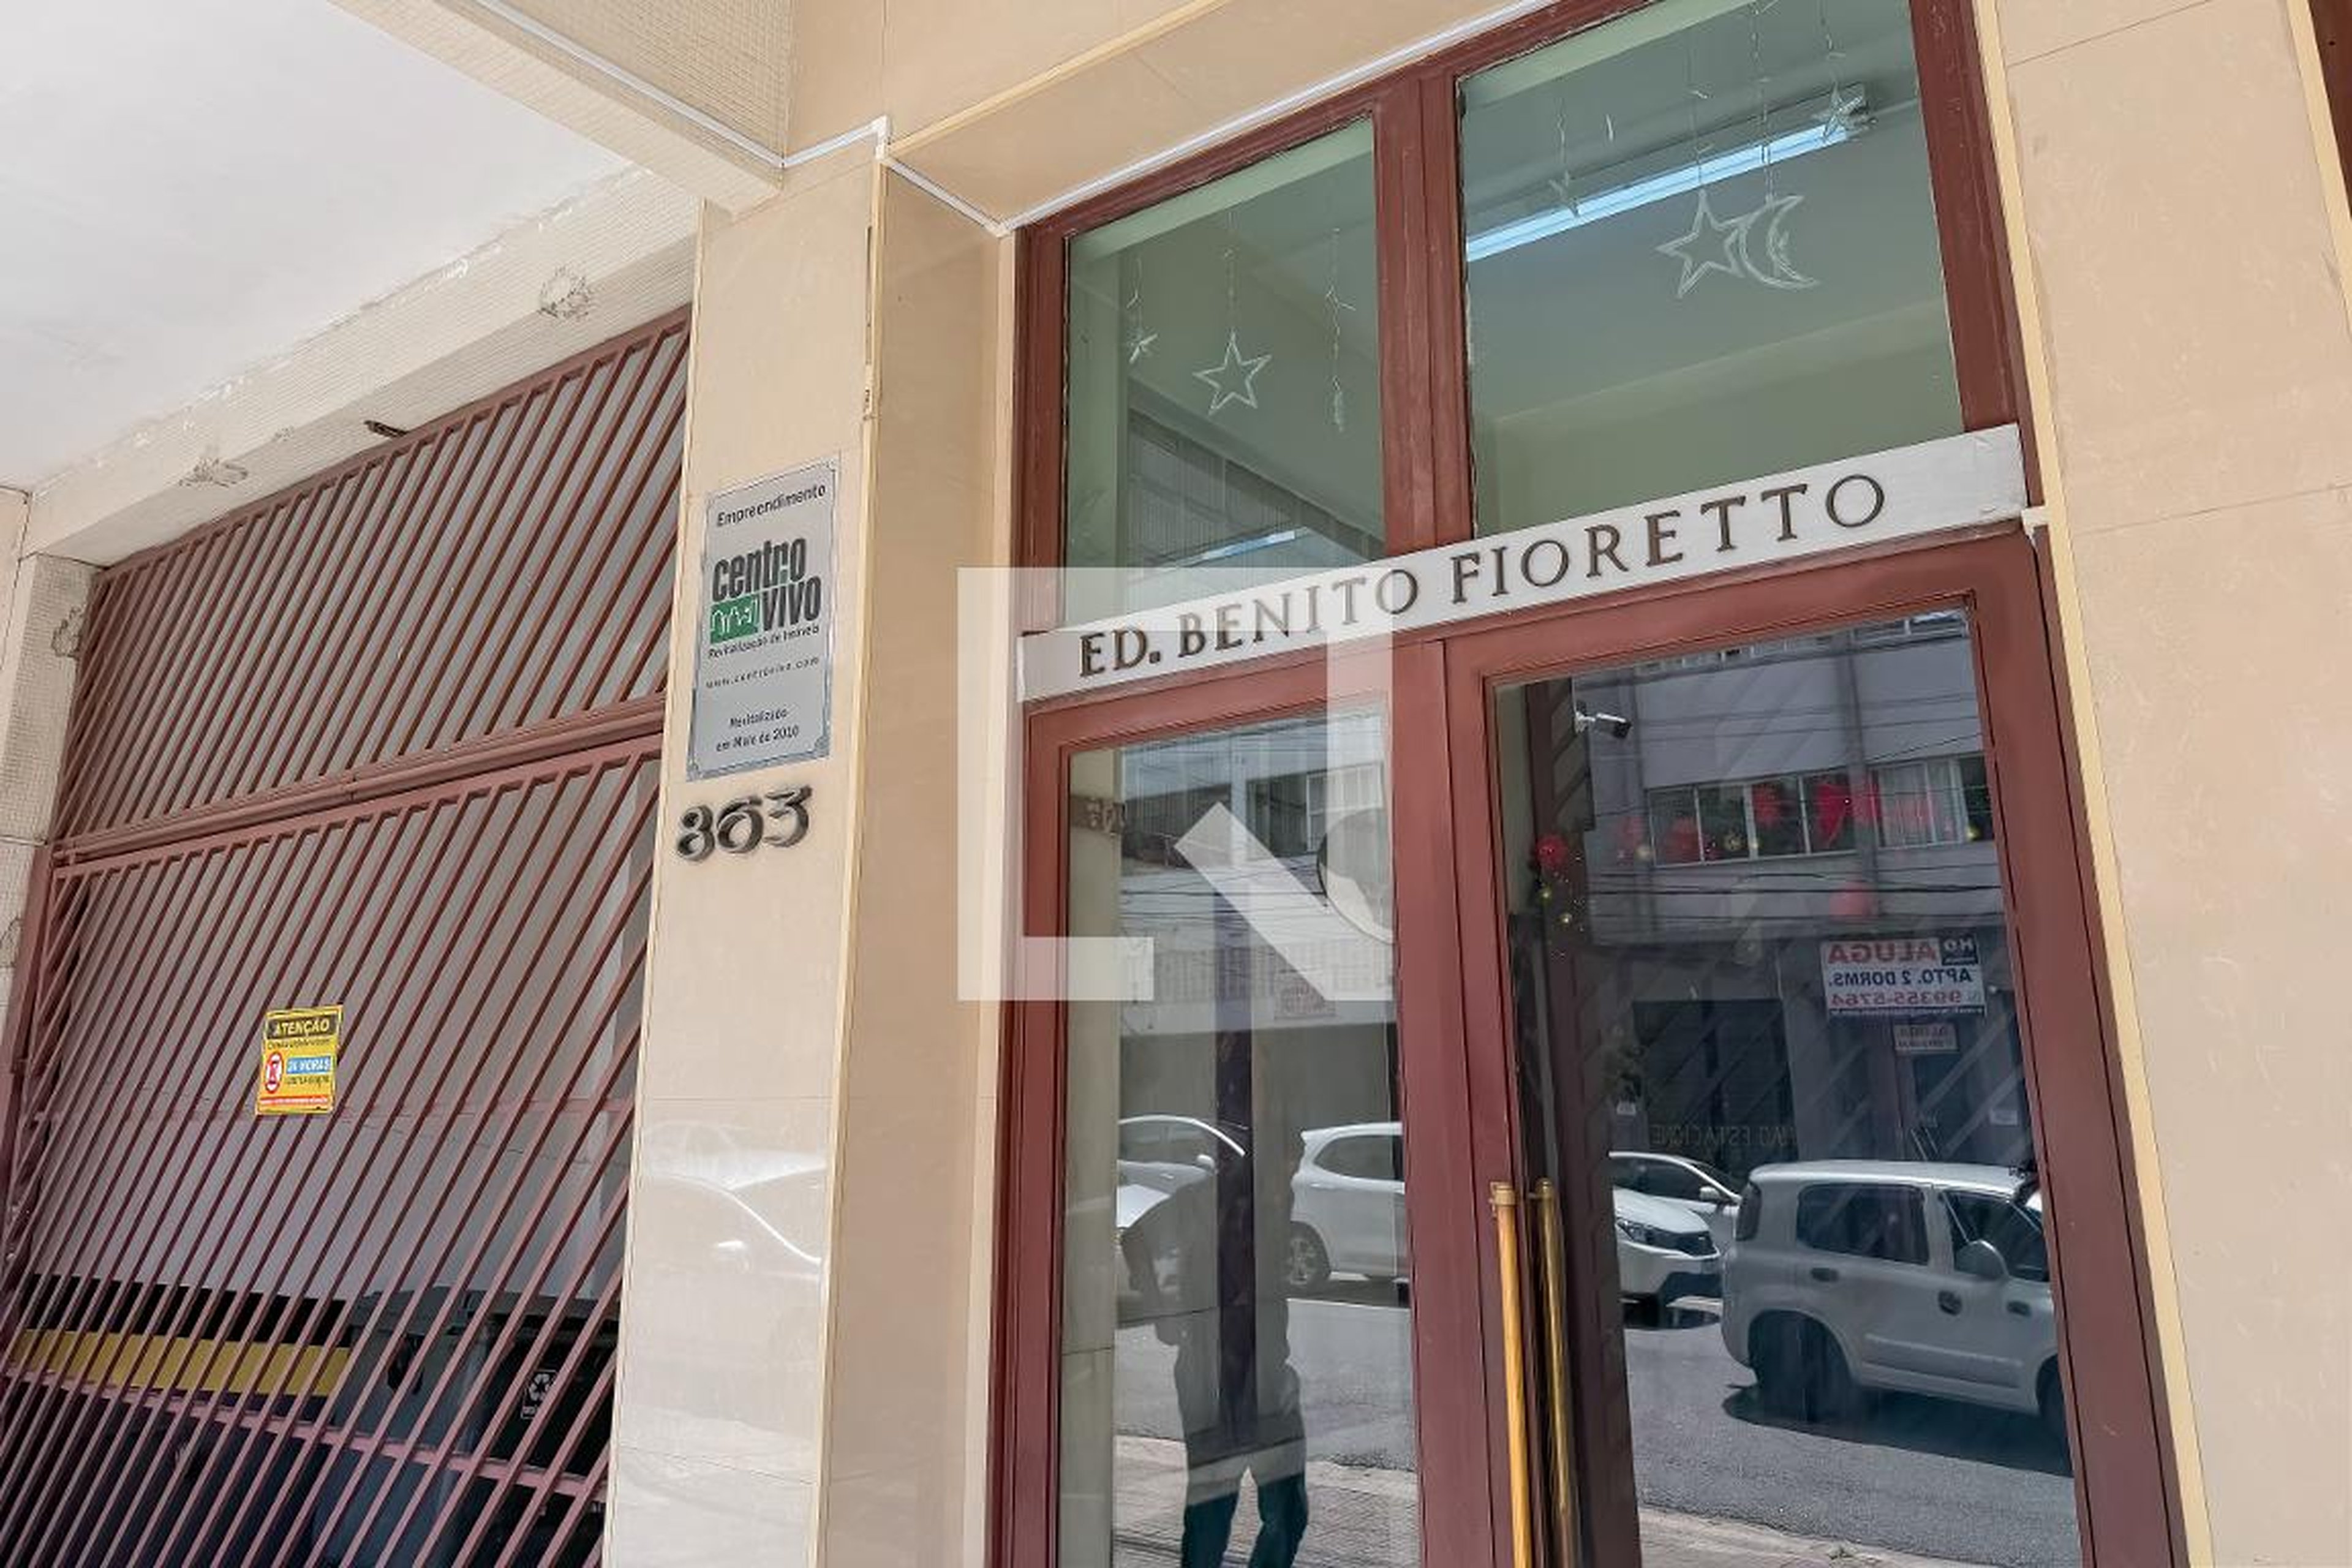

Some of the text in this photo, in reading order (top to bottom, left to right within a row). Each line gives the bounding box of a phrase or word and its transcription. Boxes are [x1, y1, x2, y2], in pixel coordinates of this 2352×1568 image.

[717, 484, 826, 527] Empreendimento
[712, 537, 807, 602] centro
[1079, 473, 1886, 677] ED. BENITO FIORETTO
[676, 785, 813, 862] 863
